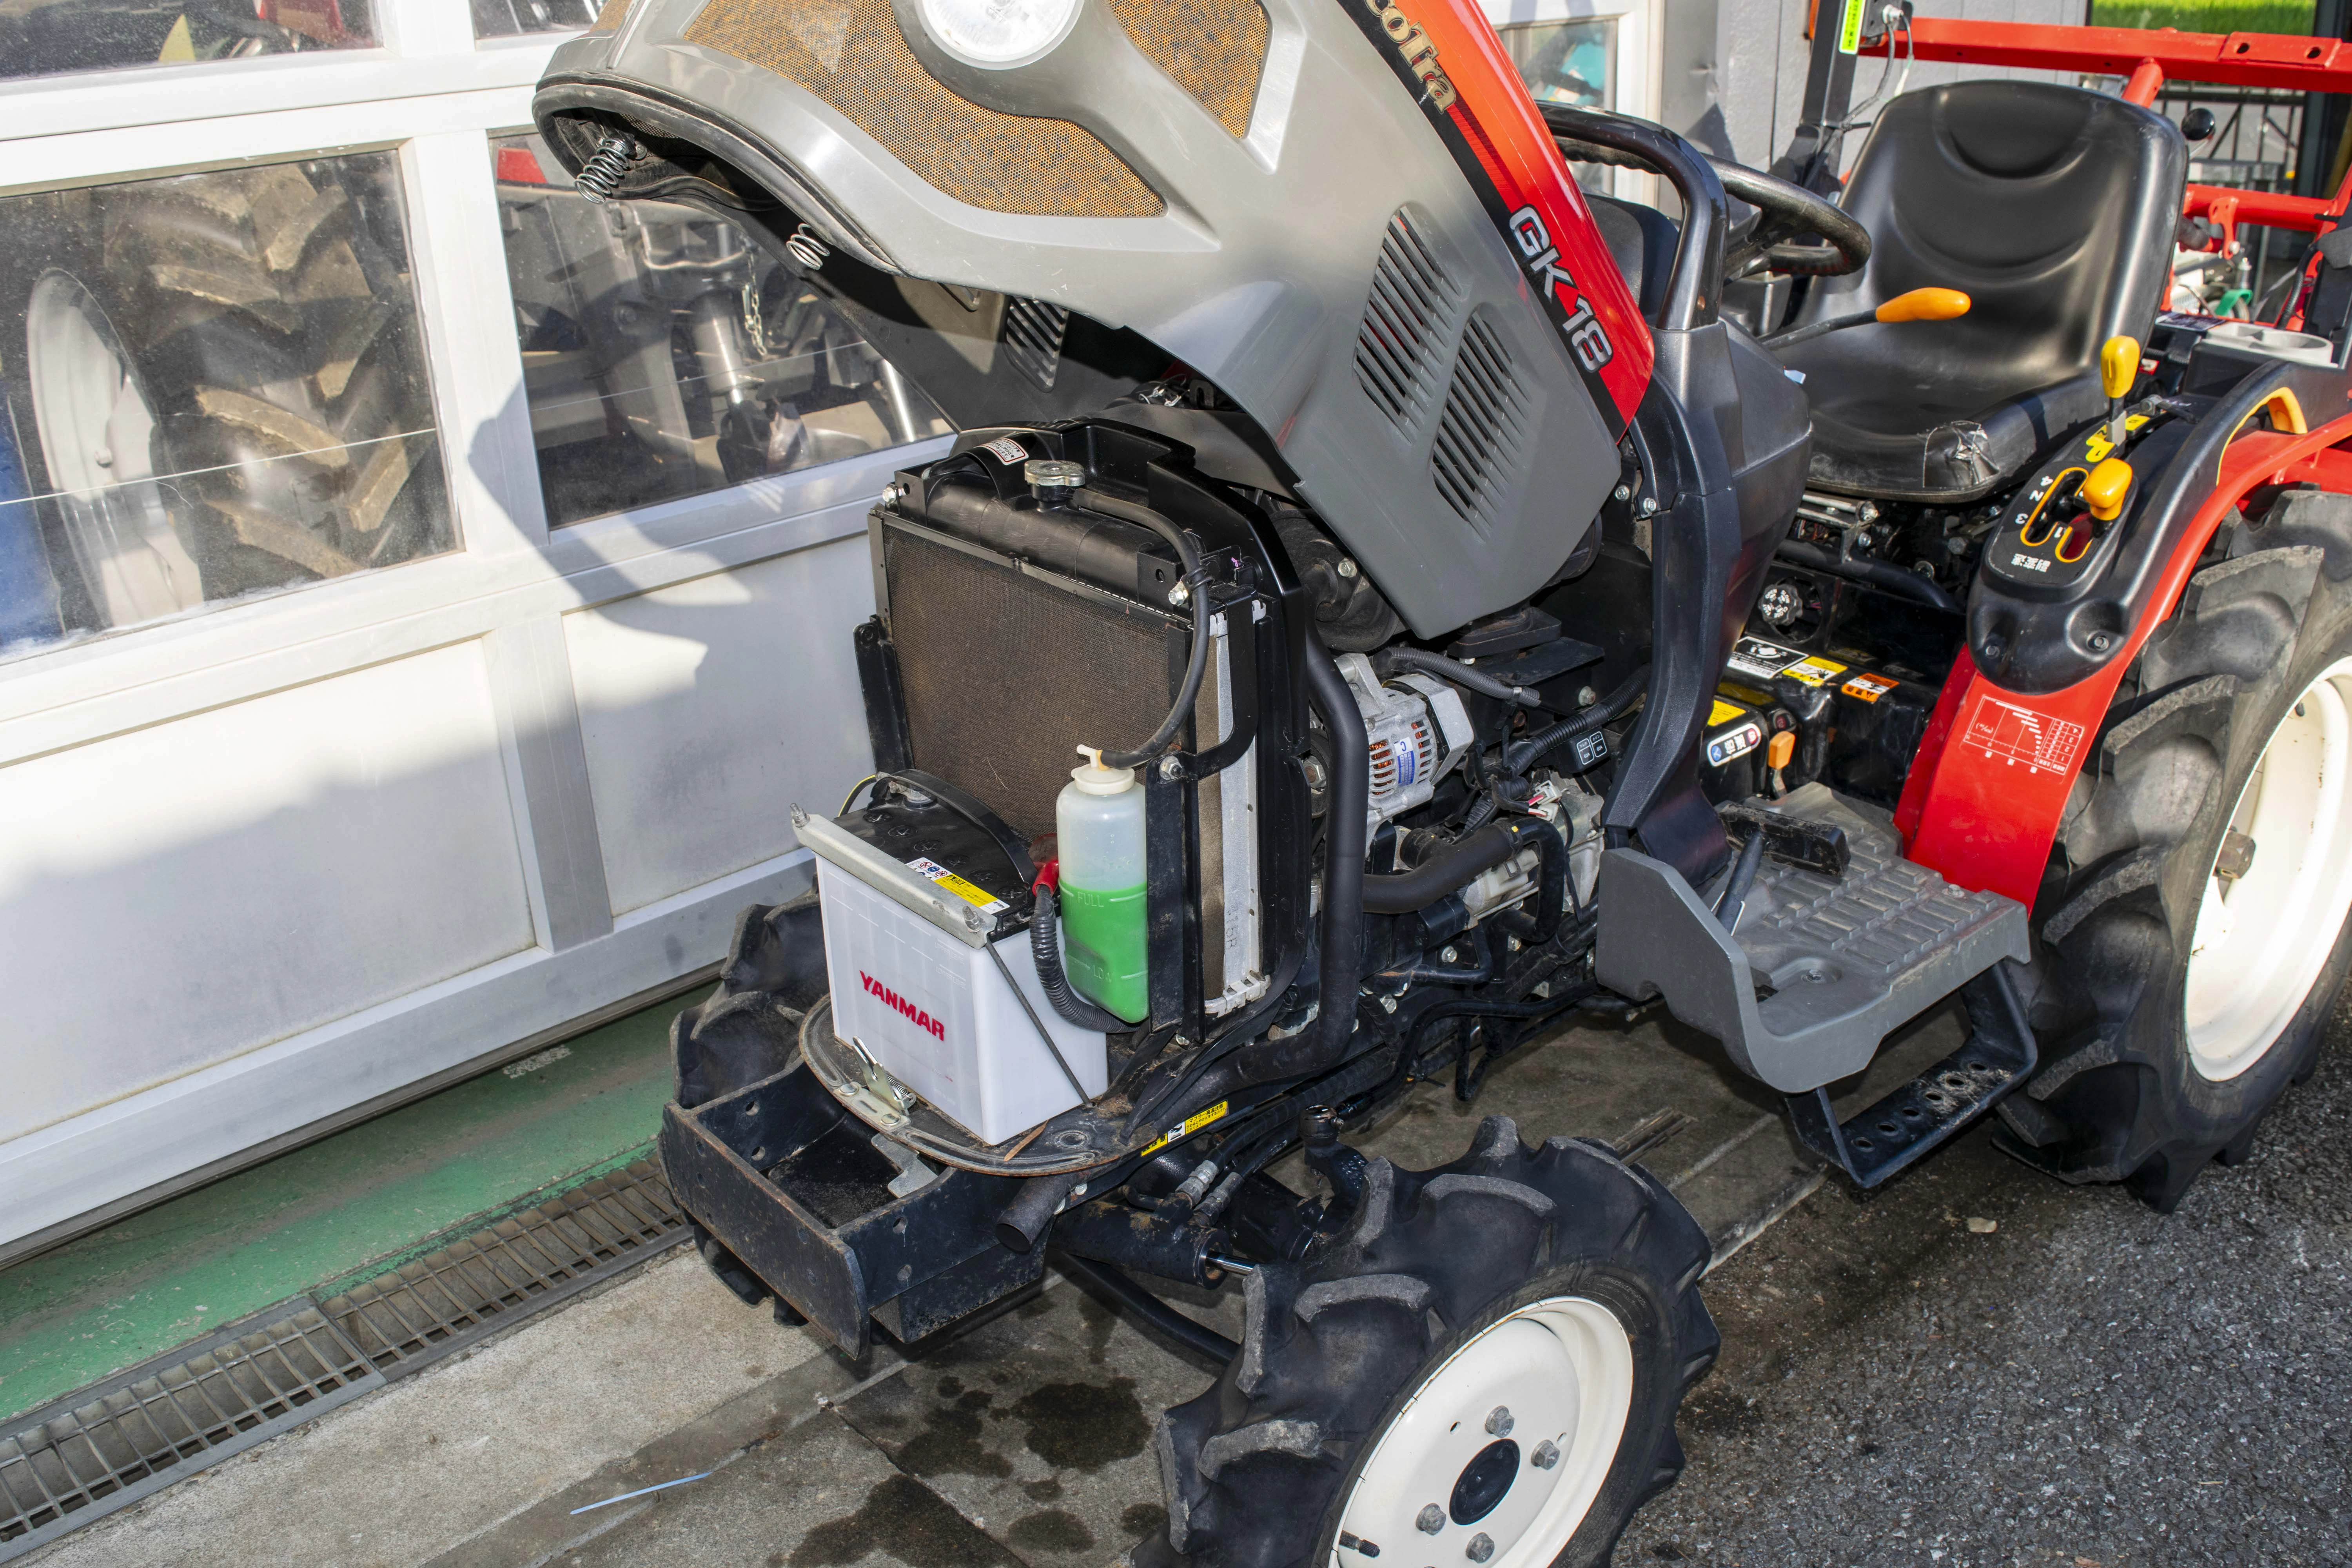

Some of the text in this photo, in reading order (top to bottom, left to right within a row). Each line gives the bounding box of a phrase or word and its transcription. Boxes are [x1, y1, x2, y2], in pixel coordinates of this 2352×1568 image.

[2040, 476, 2053, 486] 4
[2029, 490, 2044, 501] N
[2015, 513, 2028, 524] 3
[2054, 526, 2063, 538] 1
[1077, 891, 1104, 907] FULL
[859, 969, 945, 1042] YANMAR
